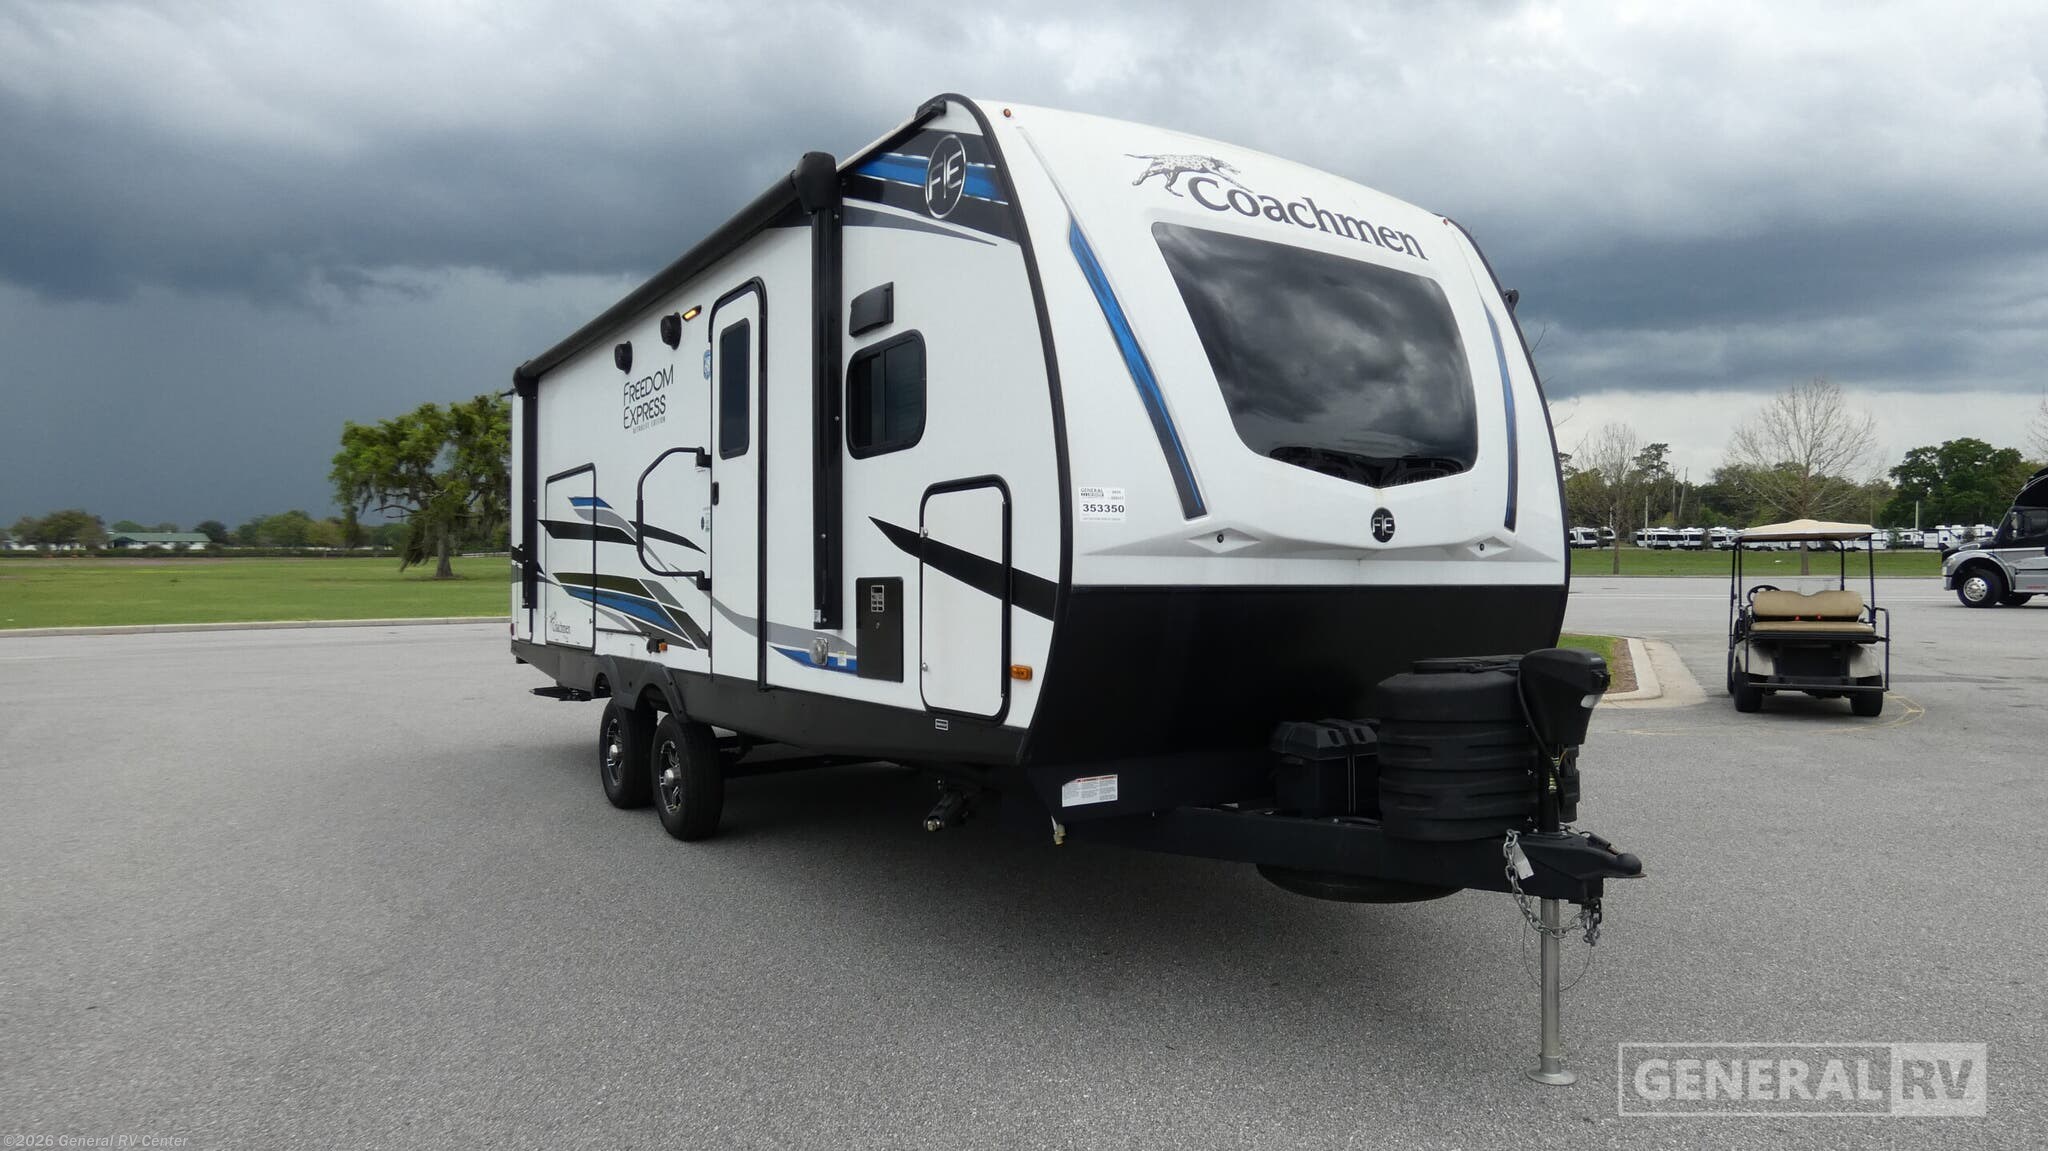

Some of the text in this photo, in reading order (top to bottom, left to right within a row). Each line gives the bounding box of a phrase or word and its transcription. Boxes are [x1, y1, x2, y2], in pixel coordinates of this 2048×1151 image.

[1187, 176, 1429, 261] Coachmen
[623, 363, 674, 407] FREEDOM
[623, 394, 667, 430] EXPRESS
[1082, 503, 1125, 513] 353350
